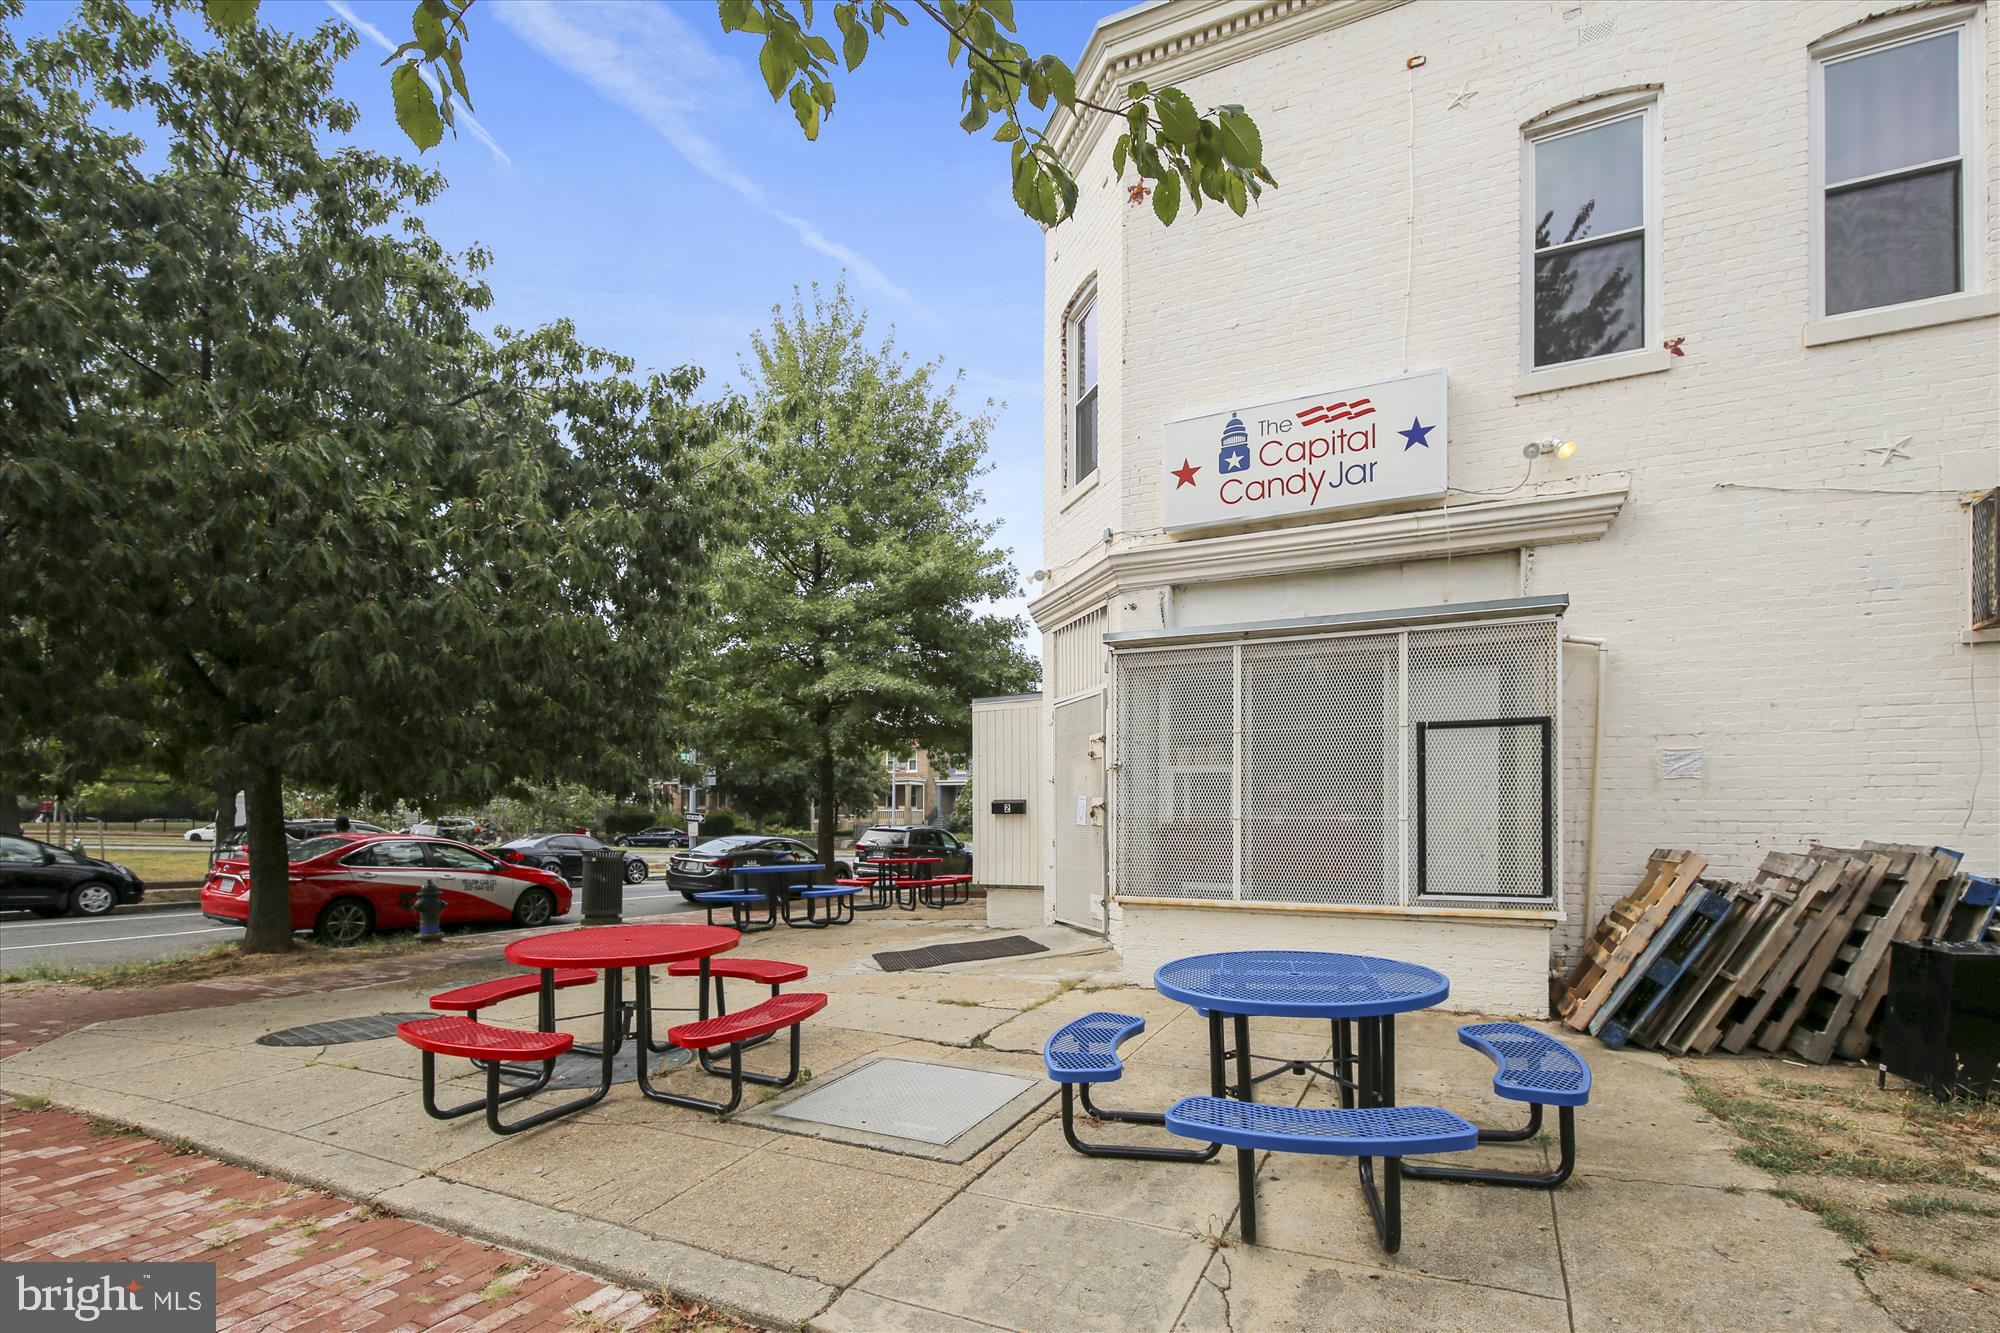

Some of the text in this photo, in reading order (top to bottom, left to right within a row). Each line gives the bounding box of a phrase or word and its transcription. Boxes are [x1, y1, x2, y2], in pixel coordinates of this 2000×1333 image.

[1258, 419, 1293, 437] The
[1259, 423, 1376, 467] Capital
[1004, 804, 1010, 813] 2
